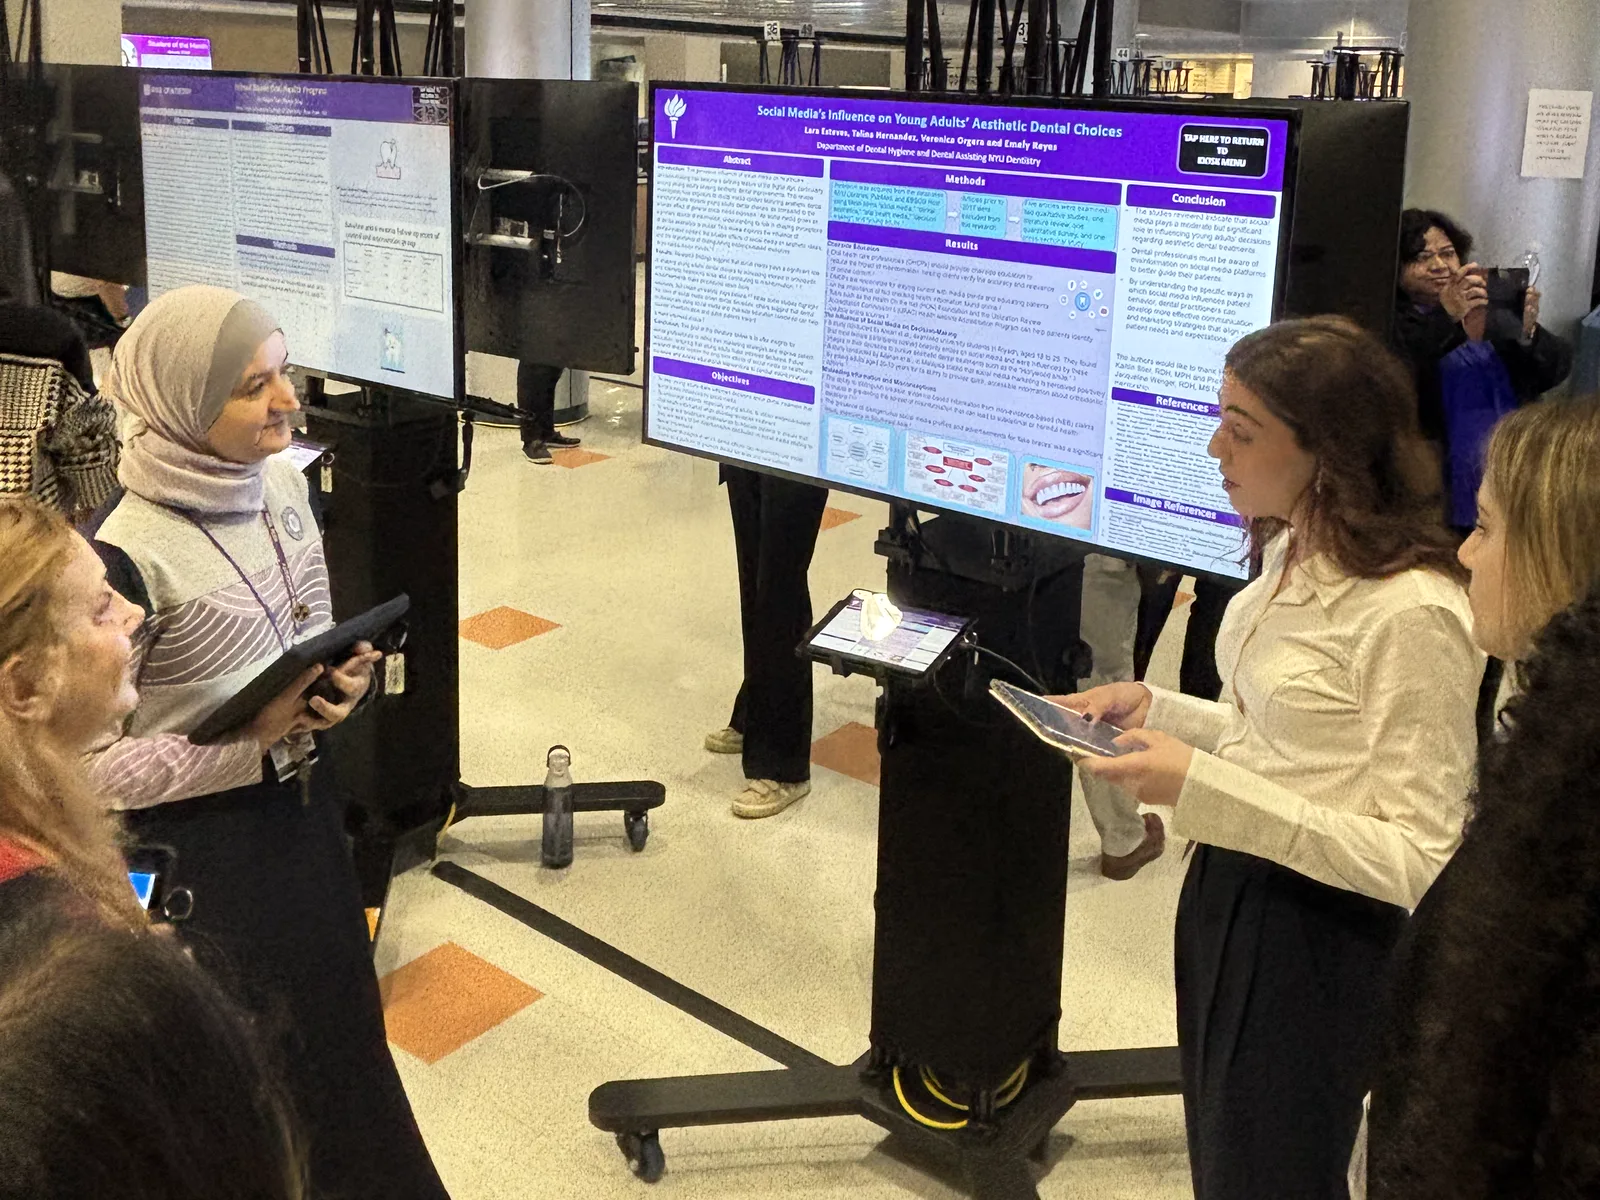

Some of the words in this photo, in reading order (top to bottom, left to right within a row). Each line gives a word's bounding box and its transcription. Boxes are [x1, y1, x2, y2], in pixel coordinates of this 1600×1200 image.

[758, 105, 785, 117] Social
[788, 107, 826, 119] Media's
[829, 109, 875, 122] Influence
[878, 115, 892, 123] on
[895, 113, 927, 128] Young
[930, 115, 969, 128] Adults'
[972, 118, 1027, 132] Aesthetic
[1030, 121, 1071, 134] Dental
[1074, 123, 1122, 137] Choices
[804, 126, 819, 134] Lara
[876, 131, 918, 142] Hernandez,
[921, 134, 955, 144] Veronica
[987, 139, 1002, 147] and
[1005, 140, 1030, 151] Emely
[1032, 142, 1057, 152] Reyes
[1184, 134, 1198, 142] TAP
[1199, 135, 1219, 143] HERE
[1220, 136, 1231, 144] TO
[1232, 137, 1264, 146] RETURN
[817, 142, 855, 150] Department
[857, 144, 864, 152] of
[865, 145, 886, 154] Dental
[888, 147, 915, 157] Hygiene
[917, 149, 930, 157] and
[931, 150, 954, 159] Dental
[956, 152, 987, 163] Assisting
[988, 154, 1005, 163] NYU
[1006, 155, 1041, 167] Dentistry
[1217, 147, 1228, 155] TO
[723, 155, 751, 165] Abstract
[1197, 157, 1220, 165] KIOSK
[1221, 158, 1246, 167] MENU
[945, 174, 986, 186] Methods
[1172, 193, 1226, 207] Conclusion
[945, 239, 978, 250] Results
[711, 371, 749, 385] Objectives
[1156, 395, 1209, 413] References
[1133, 493, 1162, 508] Image
[1164, 501, 1217, 519] References
